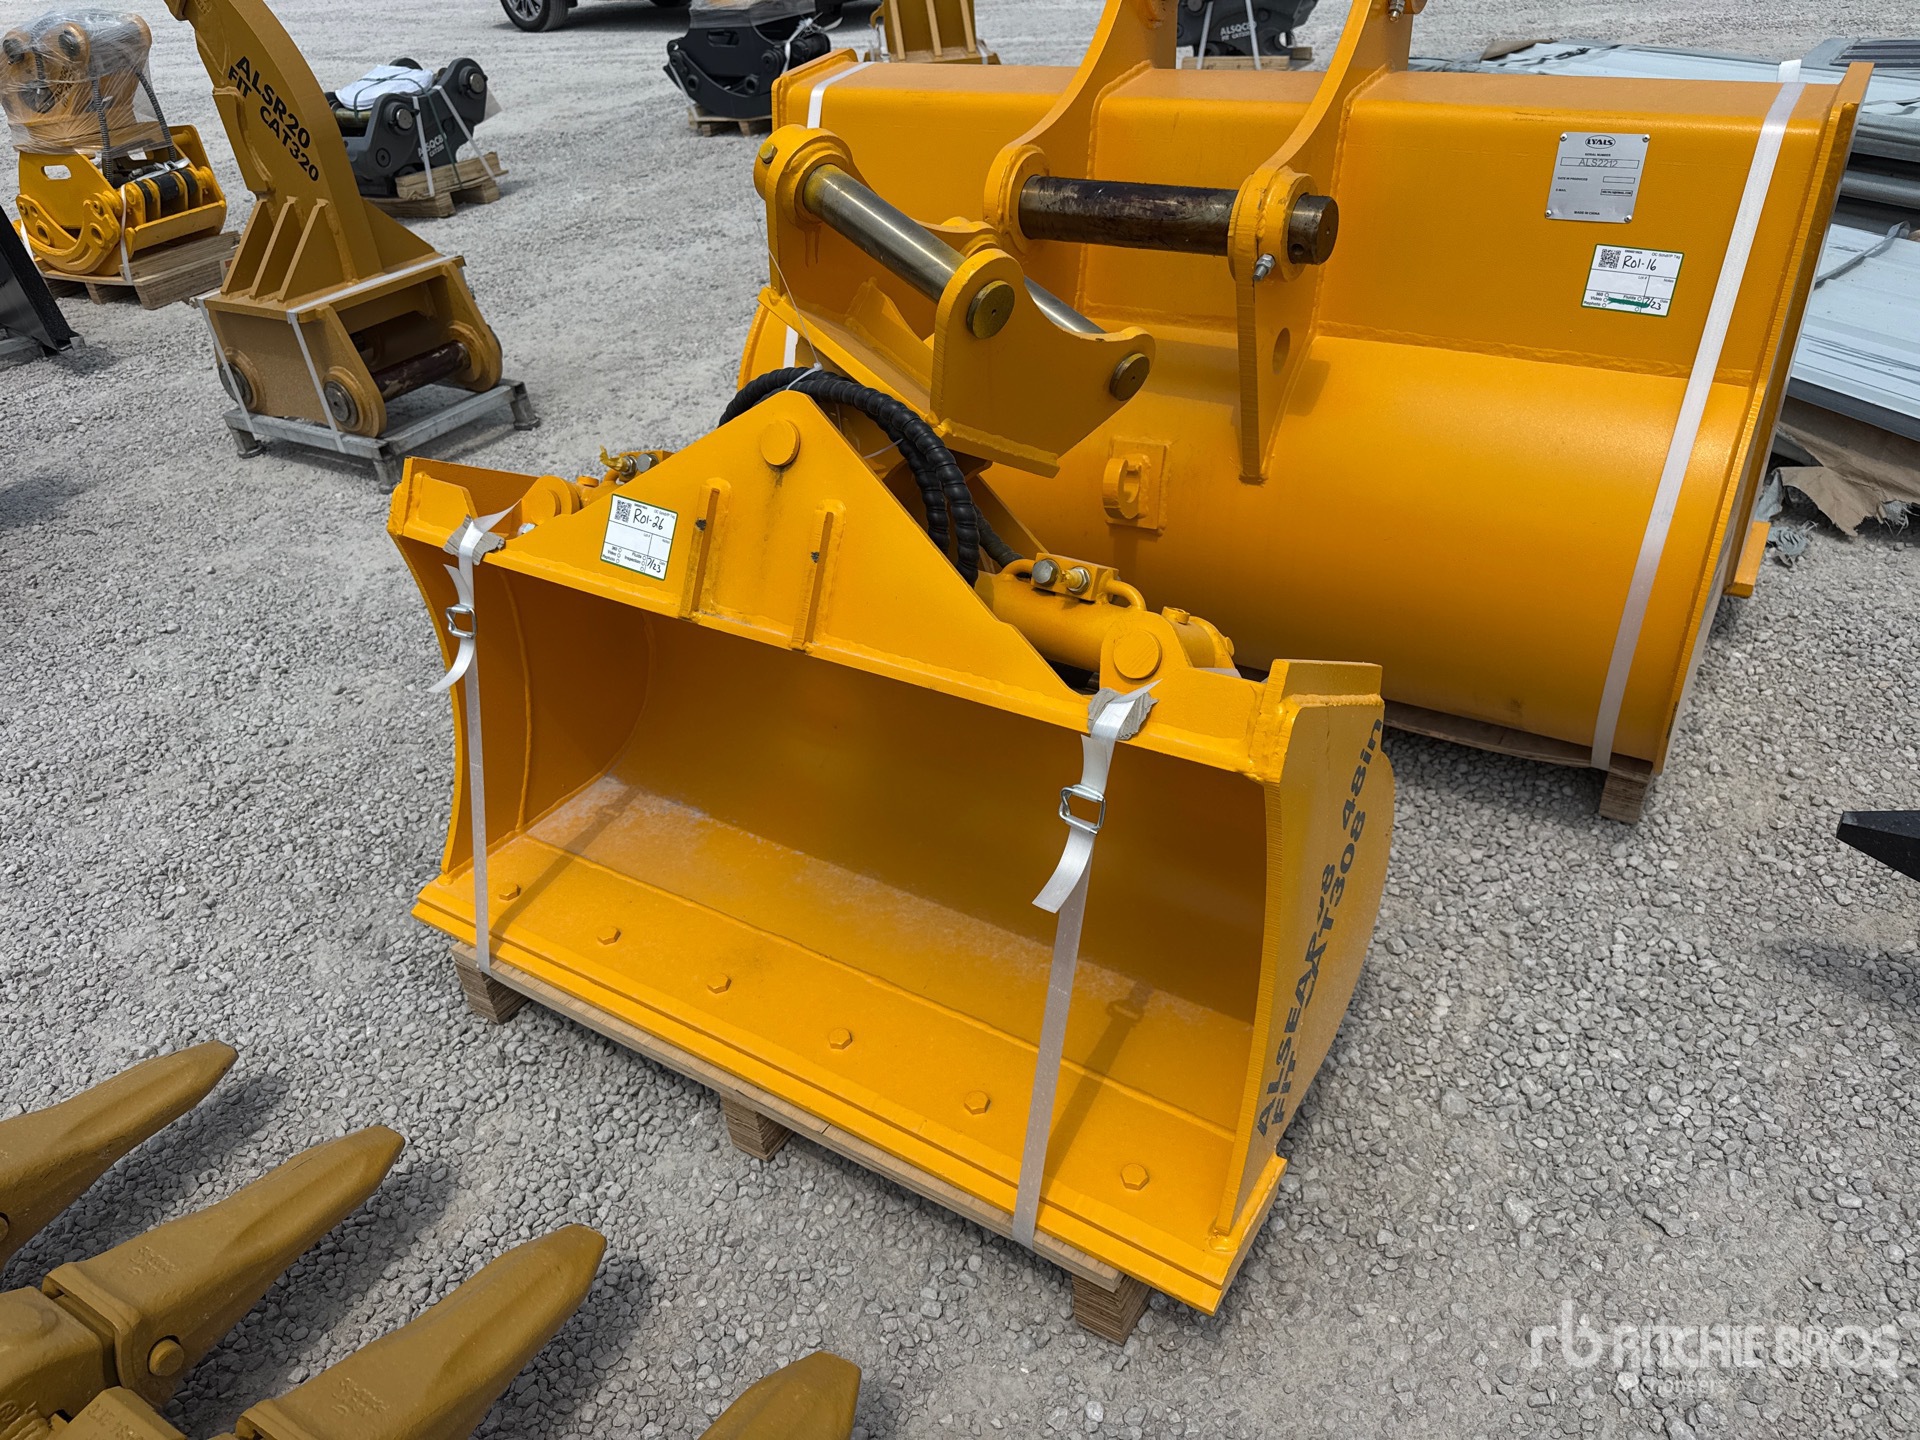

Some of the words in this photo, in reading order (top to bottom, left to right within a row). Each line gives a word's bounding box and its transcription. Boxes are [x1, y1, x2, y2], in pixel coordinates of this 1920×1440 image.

[228, 66, 252, 98] FIT
[260, 106, 319, 182] CAT320
[236, 56, 310, 148] ALSR20
[1579, 158, 1618, 168] ALS2212
[1343, 718, 1382, 830] 48in
[1272, 1050, 1296, 1124] FIT
